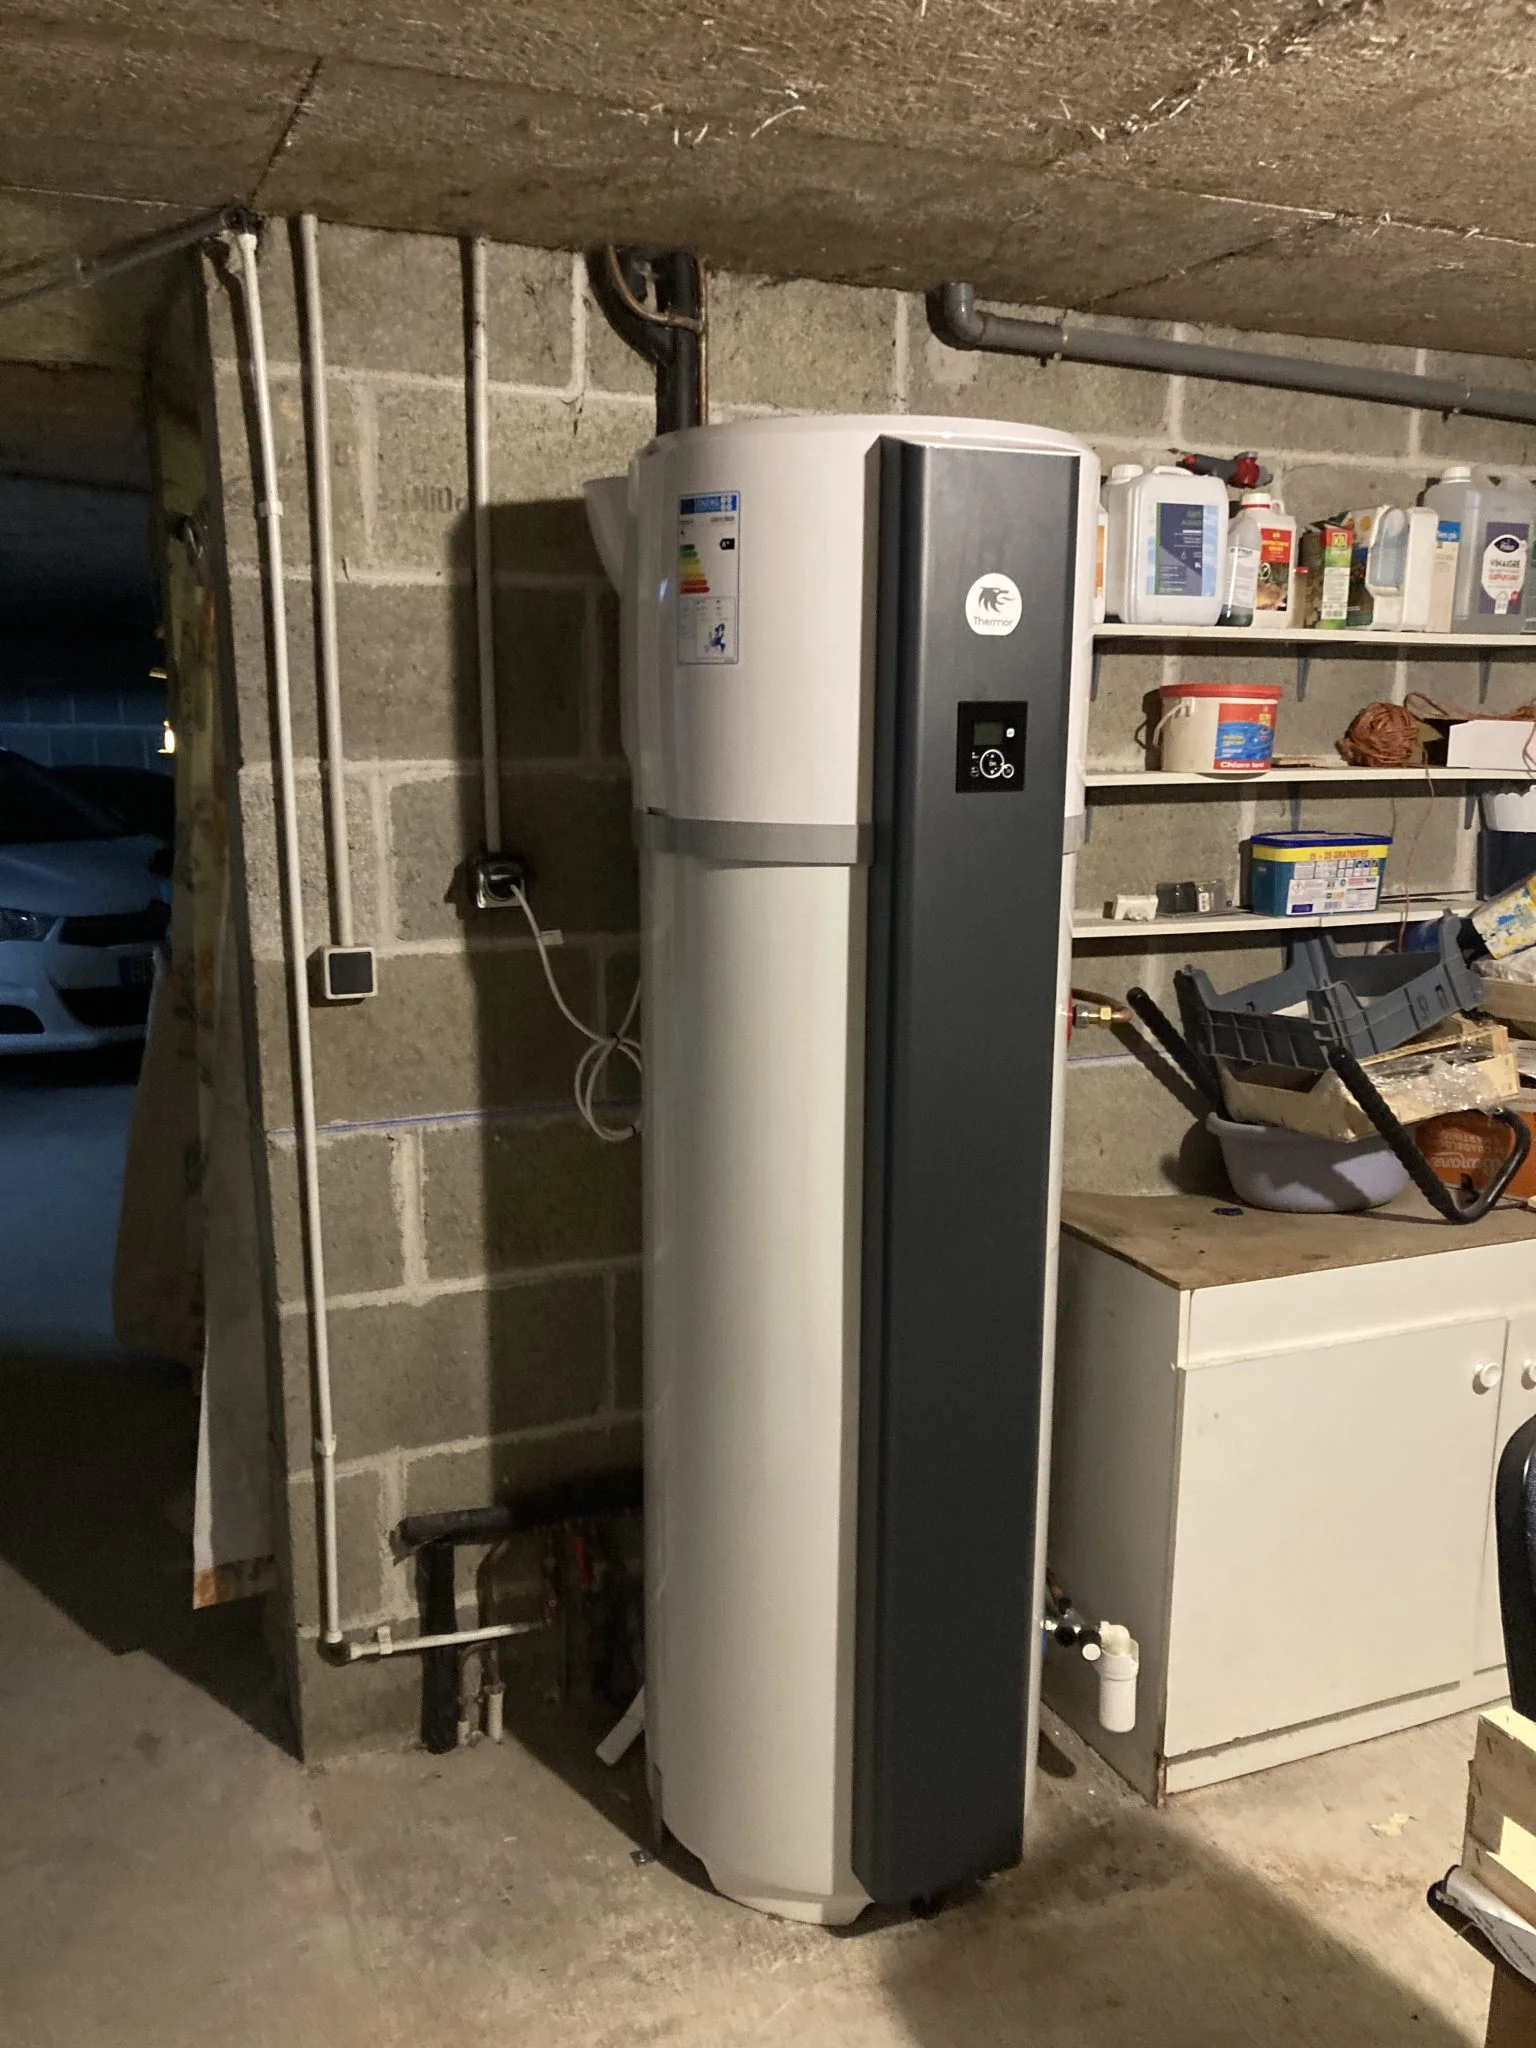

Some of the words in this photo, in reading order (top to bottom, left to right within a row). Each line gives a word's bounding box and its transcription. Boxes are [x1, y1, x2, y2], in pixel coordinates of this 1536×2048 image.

[1490, 559, 1521, 568] VINAIGRE
[973, 616, 1014, 627] Thermor
[1220, 760, 1251, 769] Chlore
